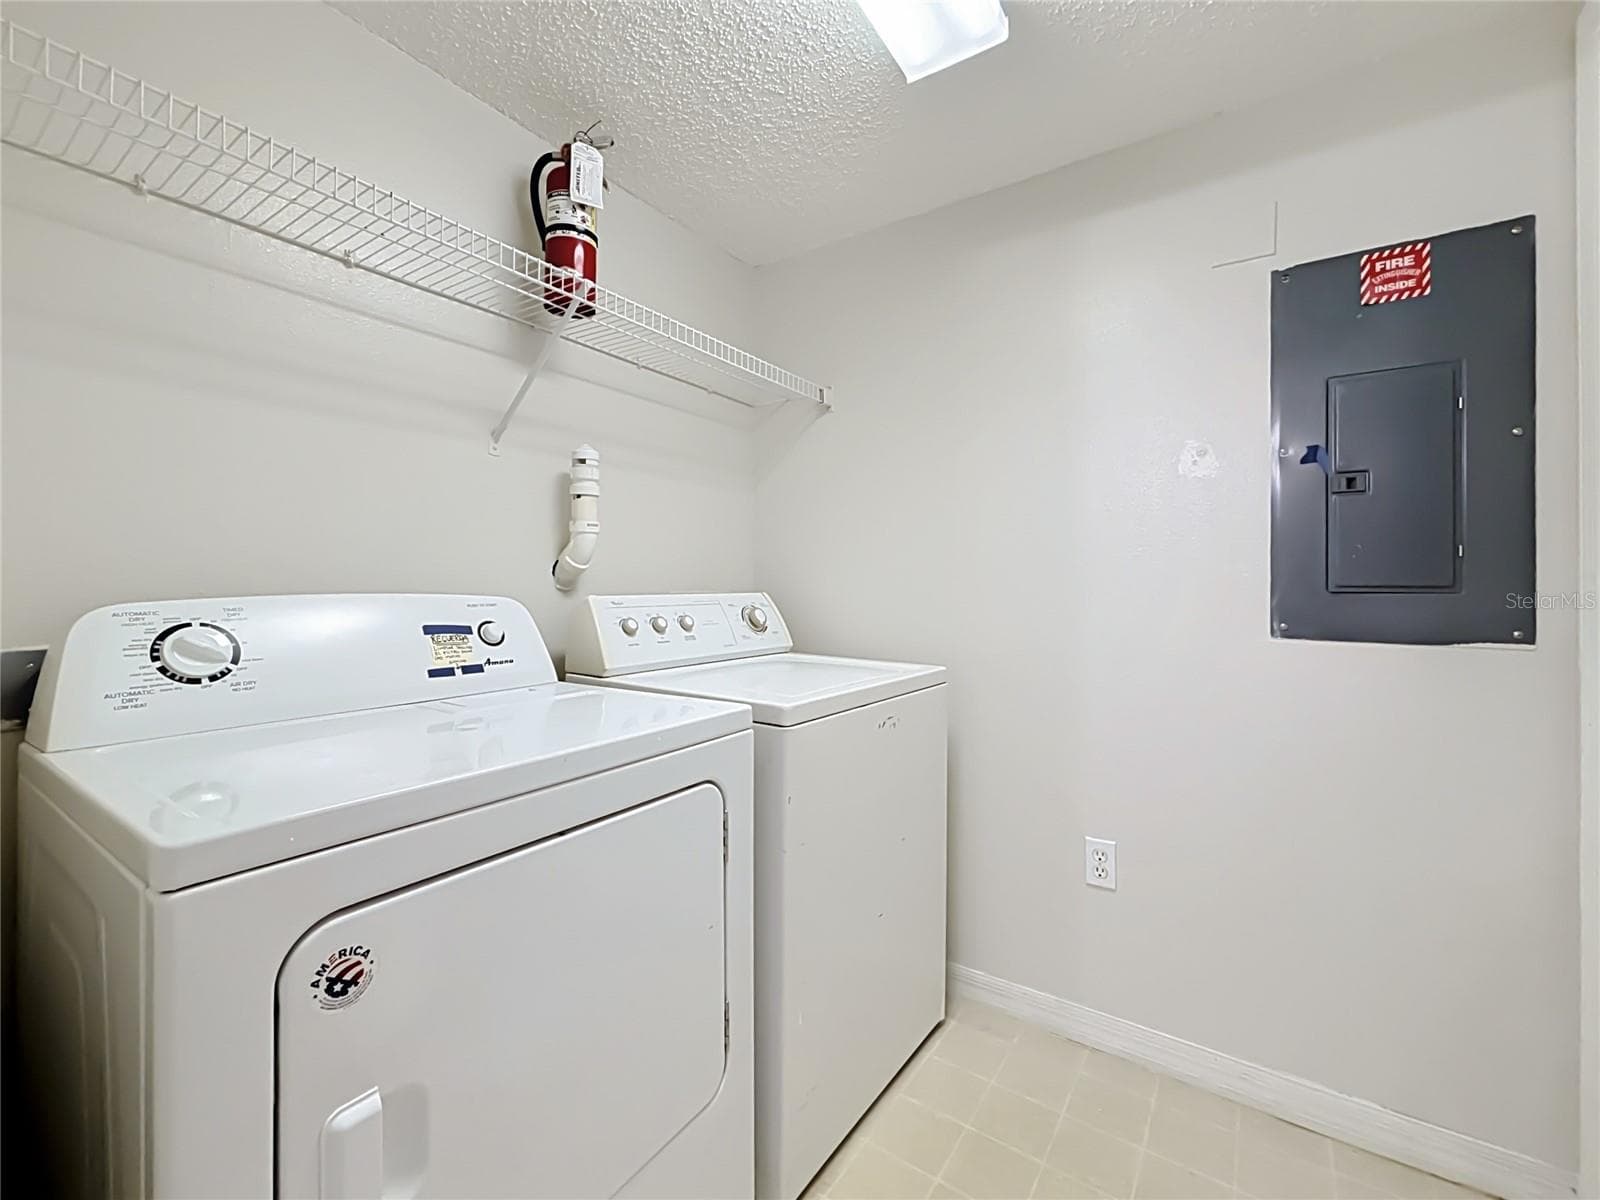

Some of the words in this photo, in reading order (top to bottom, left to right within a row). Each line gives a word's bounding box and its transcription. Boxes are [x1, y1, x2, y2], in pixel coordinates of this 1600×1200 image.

[1375, 254, 1415, 273] FIRE
[1375, 279, 1416, 293] INSIDE
[111, 610, 160, 618] AUTOMATIC
[103, 689, 156, 700] AUTOMATIC
[310, 945, 371, 989] AMERICA
